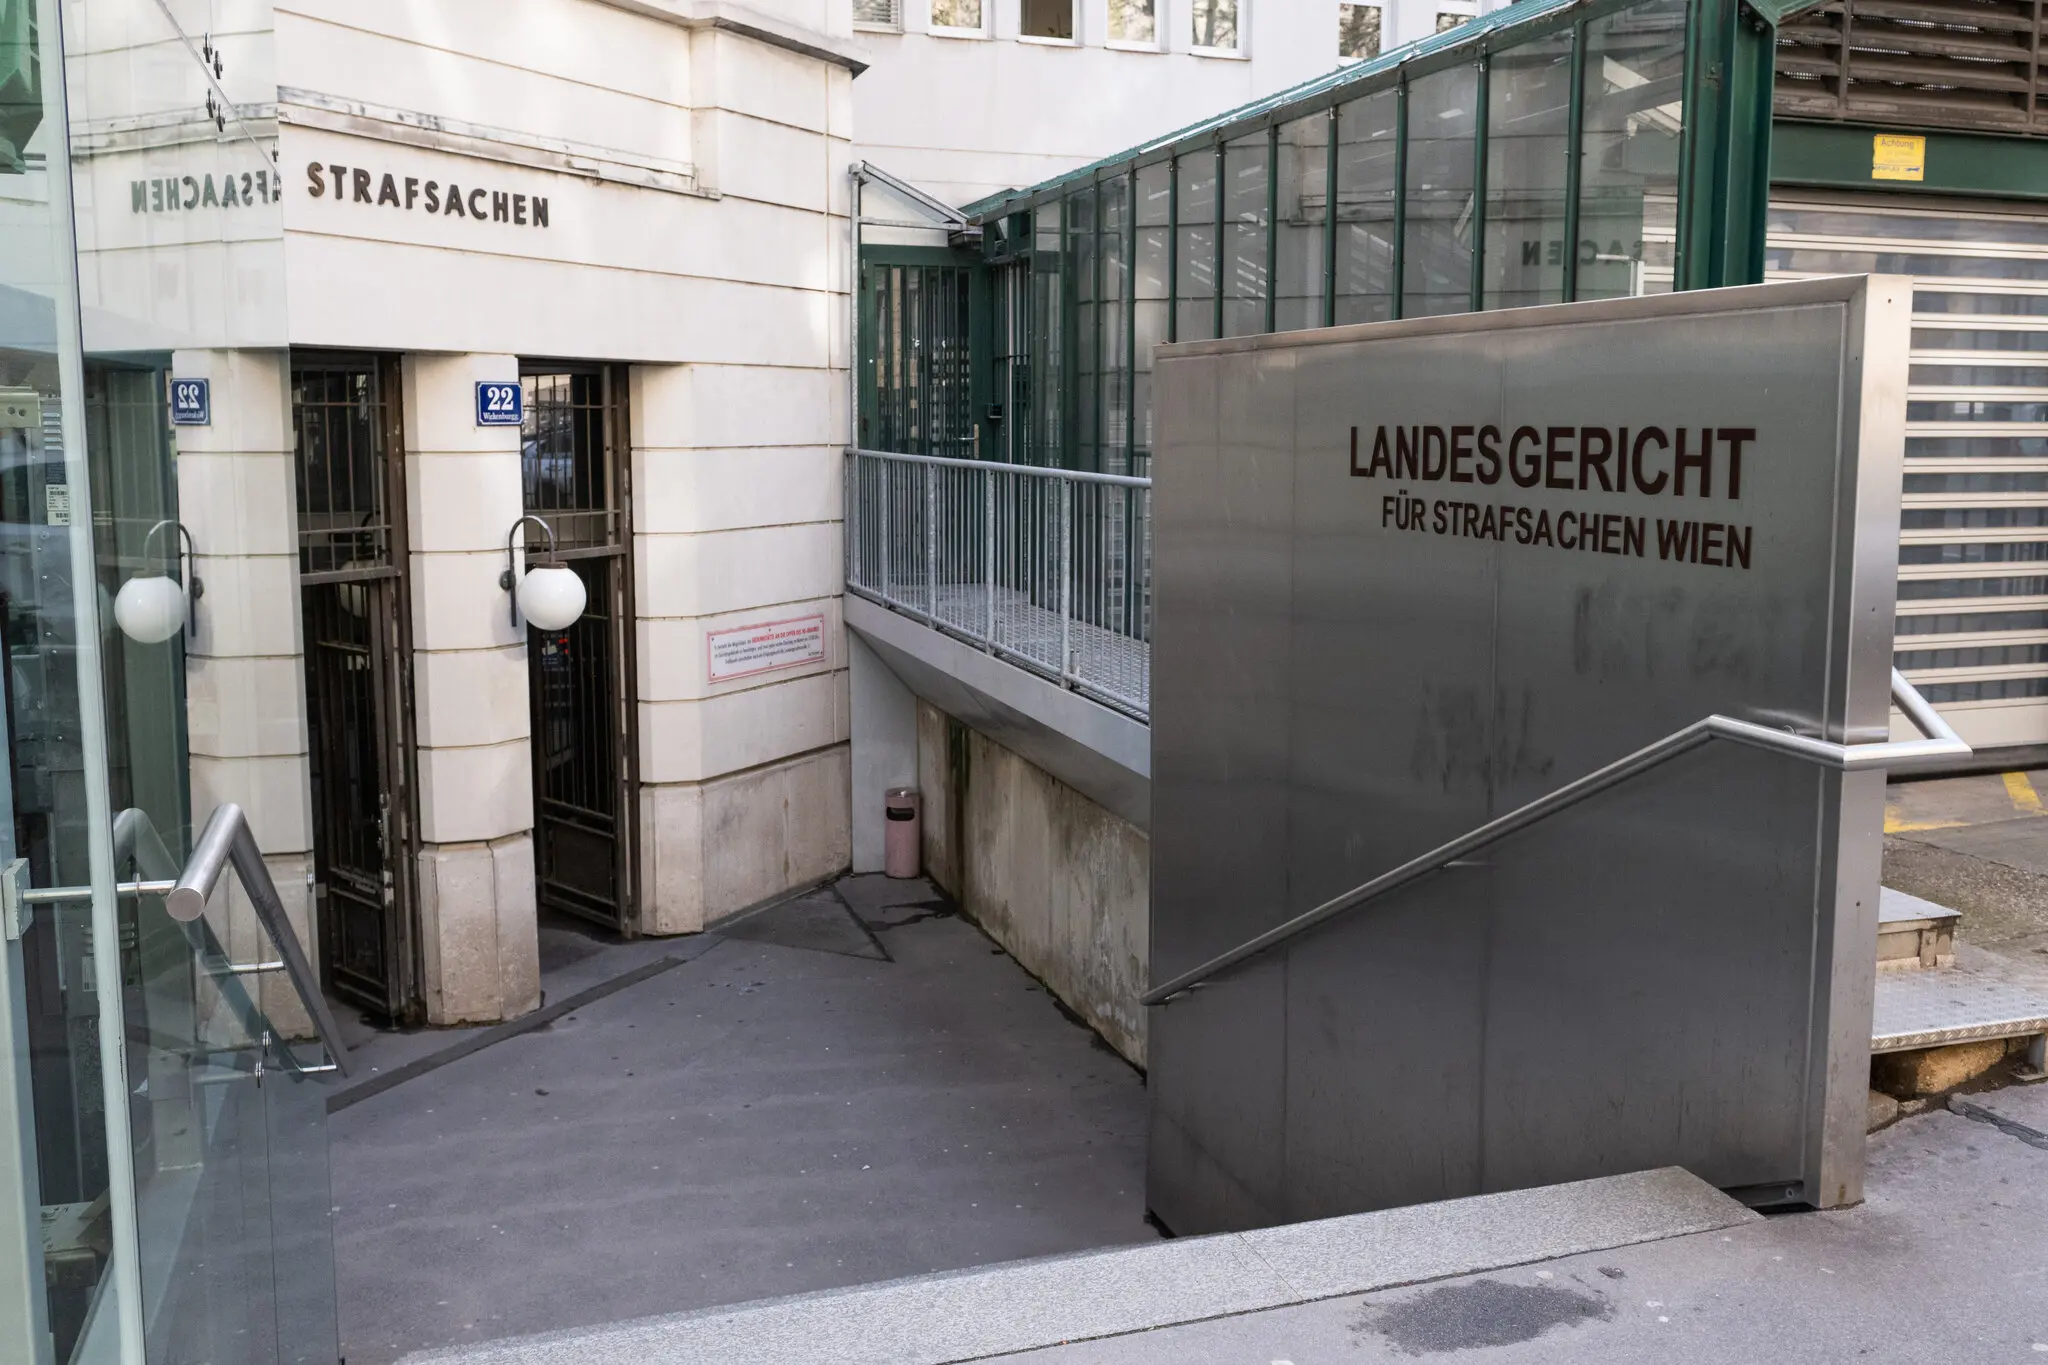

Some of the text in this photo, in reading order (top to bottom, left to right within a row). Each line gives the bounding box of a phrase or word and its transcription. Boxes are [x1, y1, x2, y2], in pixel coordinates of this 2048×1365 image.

[306, 161, 550, 228] STRAFSACHEN
[487, 386, 514, 411] 22
[1350, 424, 1757, 500] LANDESGERICHT
[1381, 489, 1753, 569] FÜR STRAFSACHEN WIEN
